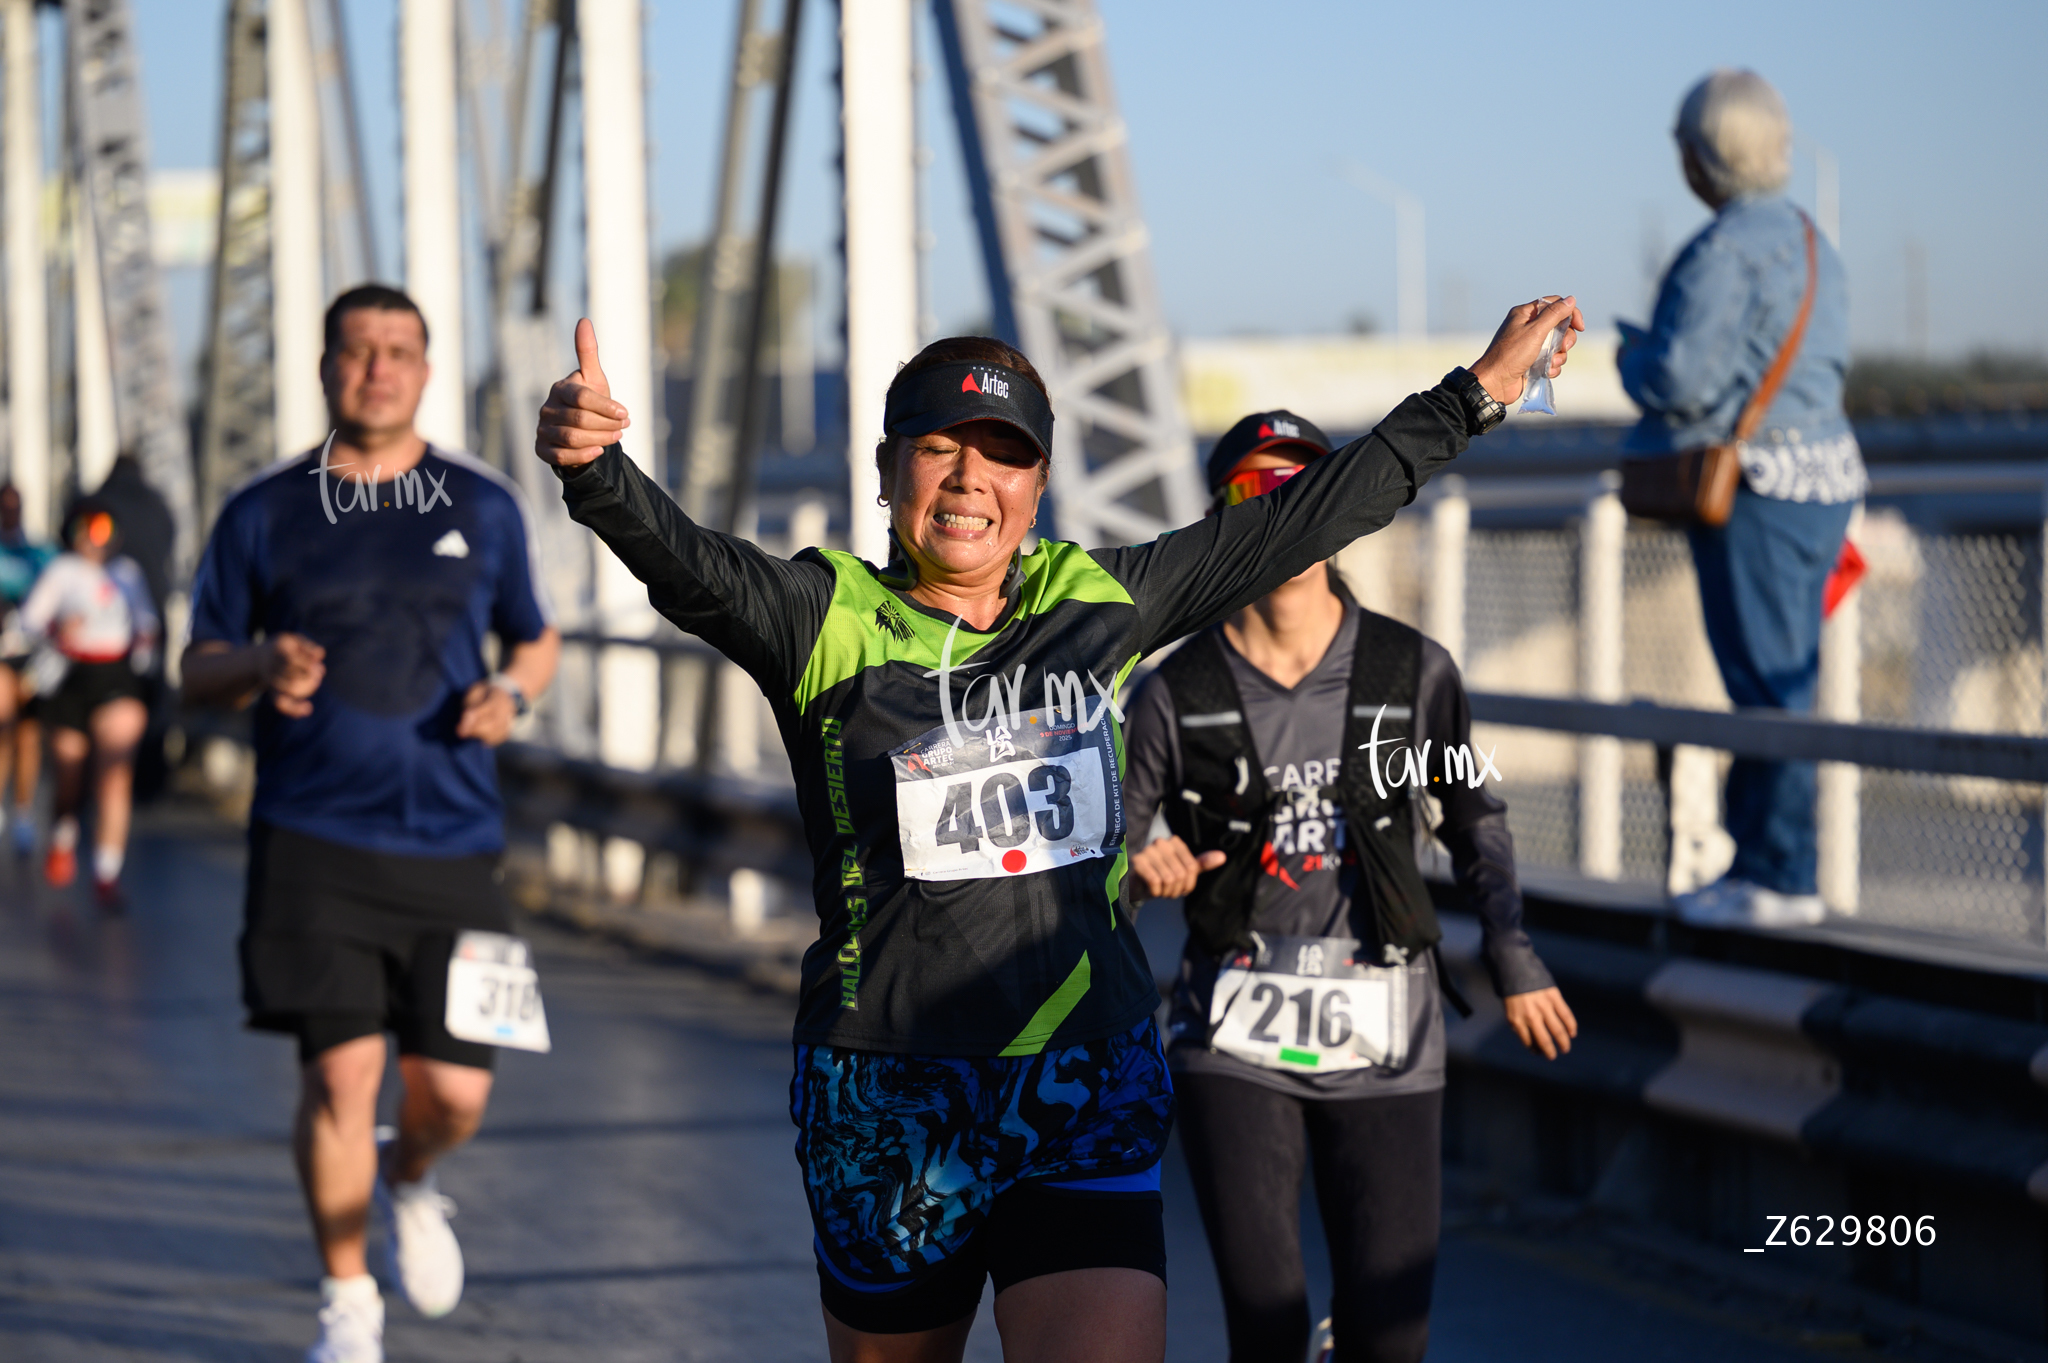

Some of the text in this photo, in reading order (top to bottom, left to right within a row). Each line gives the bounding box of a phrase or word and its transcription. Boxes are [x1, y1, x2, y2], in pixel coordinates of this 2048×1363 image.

[981, 372, 1009, 399] Artec
[1049, 723, 1075, 731] DOMINGO
[921, 741, 951, 754] CARRERA
[922, 747, 952, 759] GRUPO
[924, 754, 954, 766] ARTEC
[821, 717, 856, 834] DESIERTO
[1110, 770, 1118, 782] DE
[935, 764, 1075, 854] 403
[1113, 798, 1121, 811] DE
[1109, 812, 1121, 846] ENTREGA
[842, 844, 863, 886] DEL
[1248, 982, 1353, 1048] 216
